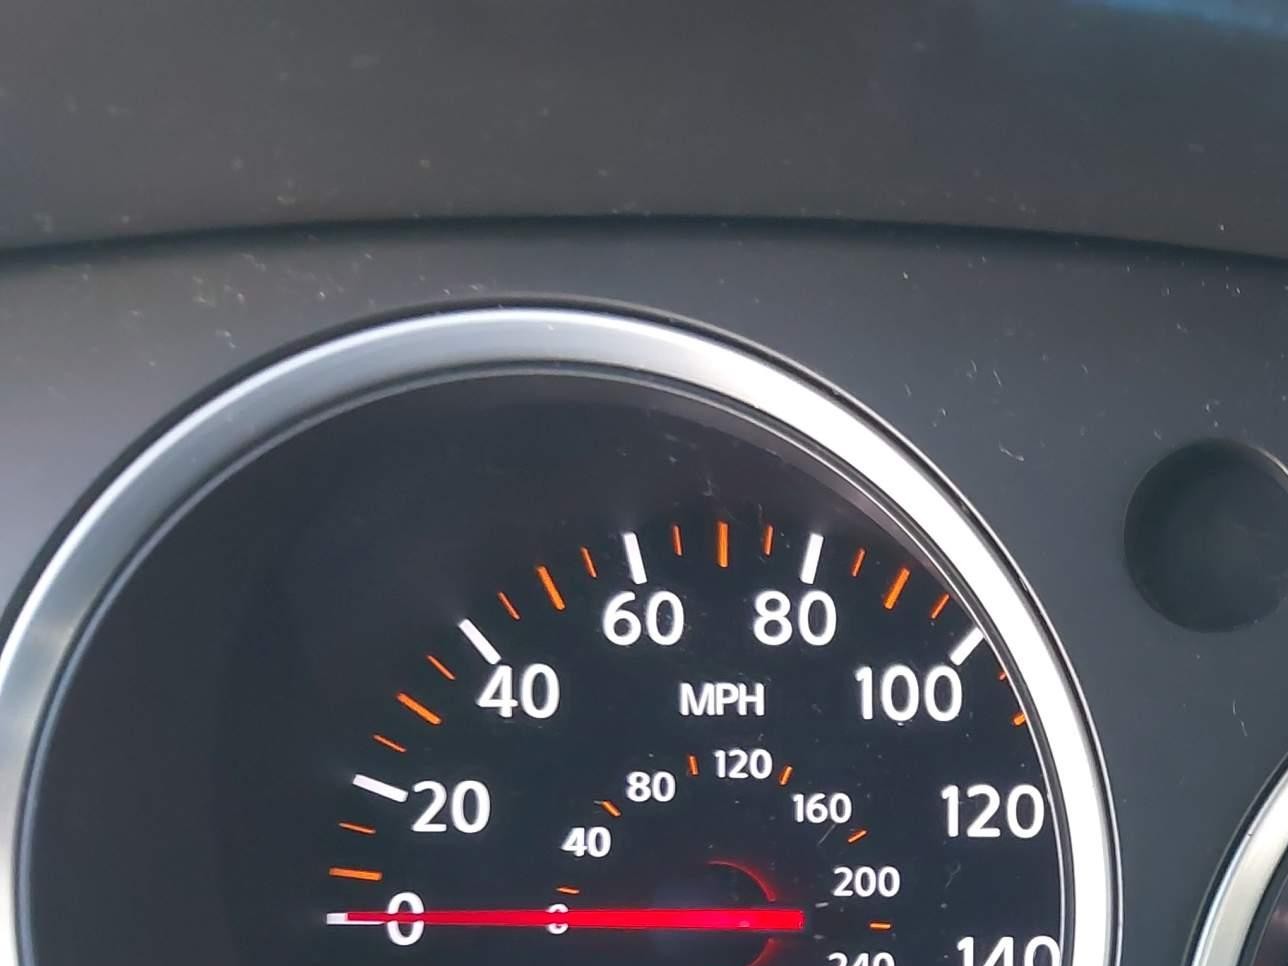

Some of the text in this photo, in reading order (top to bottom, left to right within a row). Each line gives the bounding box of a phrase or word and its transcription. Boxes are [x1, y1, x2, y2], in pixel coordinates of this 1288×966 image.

[603, 591, 684, 645] 60
[753, 590, 836, 645] 80
[477, 664, 559, 719] 40
[680, 683, 764, 715] MPH
[855, 666, 963, 722] 100
[627, 772, 675, 802] 80
[715, 749, 772, 779] 120
[410, 781, 490, 833] 20
[793, 793, 851, 823] 160
[941, 785, 1044, 838] 120
[562, 827, 611, 857] 40
[833, 866, 900, 897] 200
[386, 892, 424, 945] 0
